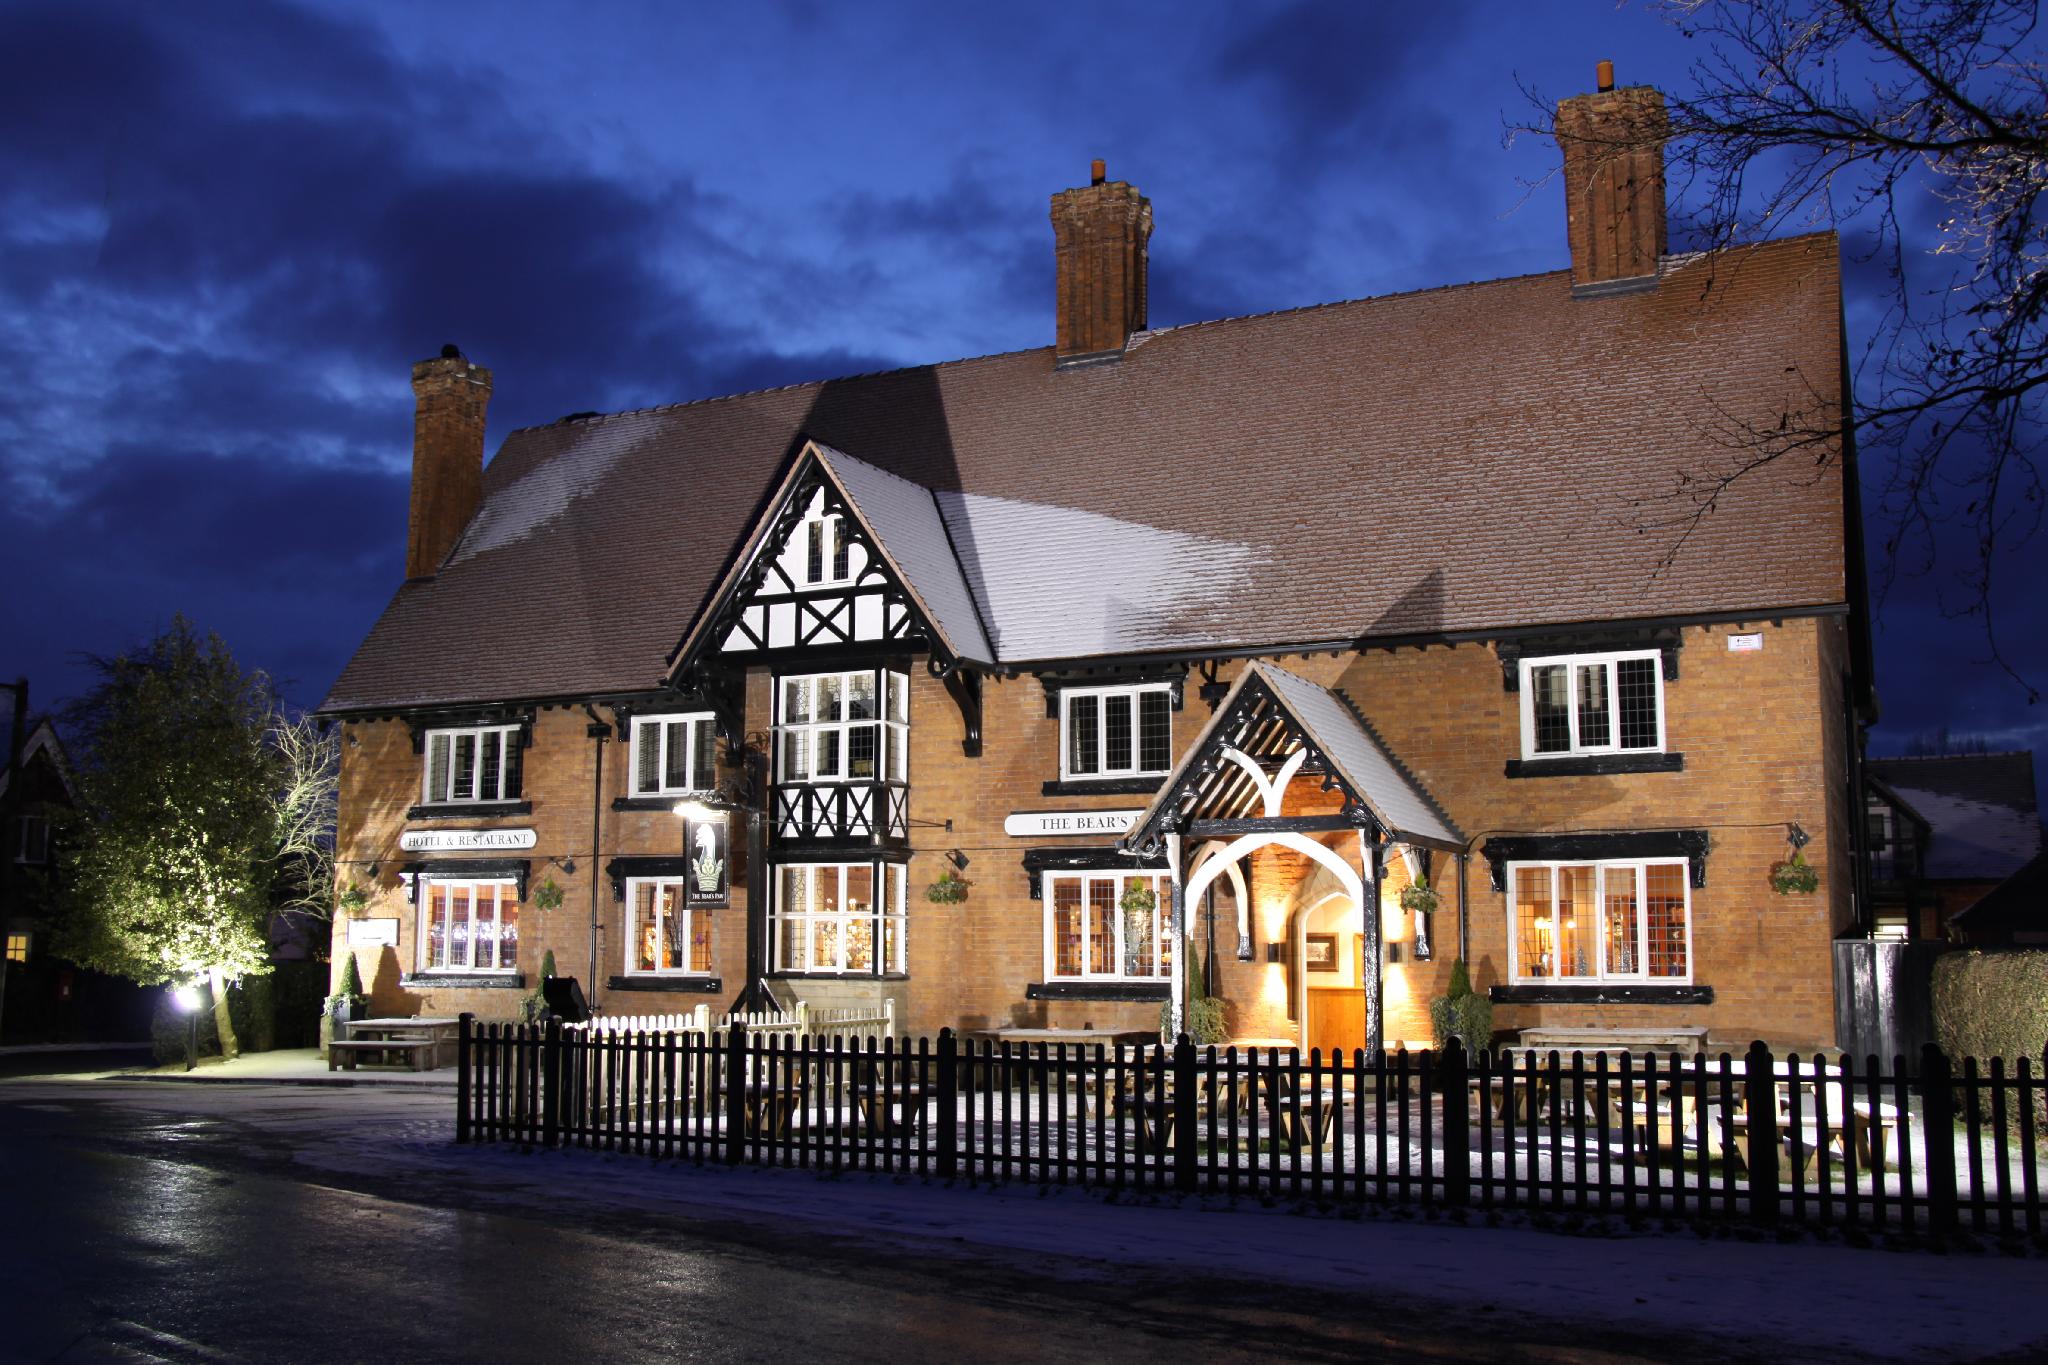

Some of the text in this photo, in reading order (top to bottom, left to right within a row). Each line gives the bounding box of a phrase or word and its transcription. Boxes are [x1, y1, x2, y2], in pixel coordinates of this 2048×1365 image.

[1040, 818, 1071, 830] THE
[1077, 816, 1128, 829] BEAR'S
[408, 833, 529, 847] HOTEL & RESTAURANT
